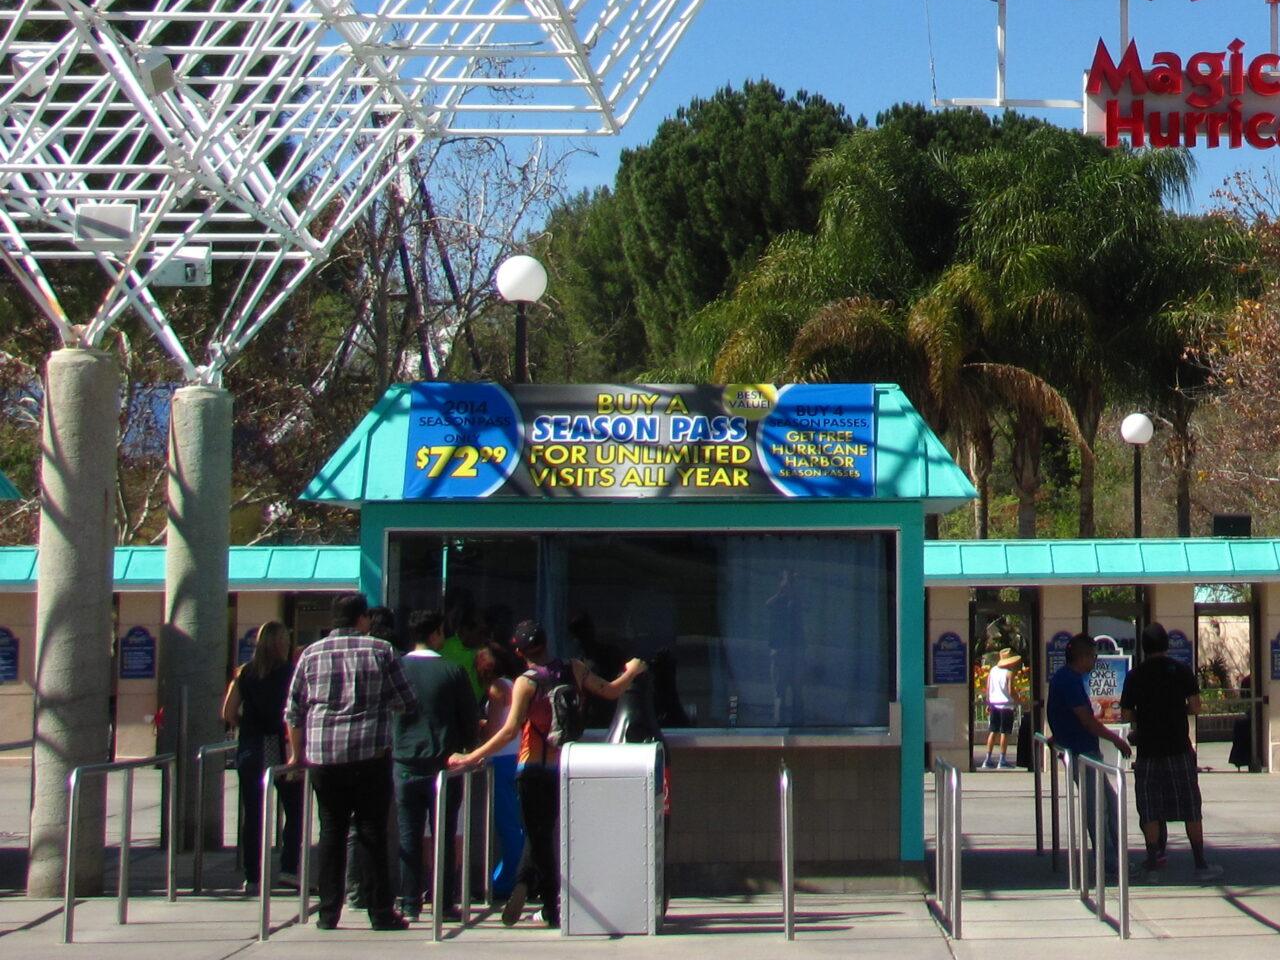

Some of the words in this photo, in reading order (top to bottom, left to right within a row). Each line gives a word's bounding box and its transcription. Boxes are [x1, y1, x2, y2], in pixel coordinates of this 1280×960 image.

[737, 391, 764, 400] BEST
[444, 401, 488, 414] 2014
[597, 393, 659, 415] BUY
[665, 393, 689, 415] A
[729, 400, 771, 409] VALUE!
[796, 405, 829, 416] BUY
[833, 404, 844, 416] 4
[418, 416, 474, 426] SEASON
[478, 416, 512, 426] PASS
[769, 419, 821, 428] SEASON
[824, 419, 870, 428] PASSES,
[531, 415, 660, 442] SEASON
[669, 416, 749, 442] PASS
[786, 431, 816, 442] GET
[819, 431, 853, 442] FREE
[529, 445, 588, 464] FOR
[595, 444, 751, 465] UNLIMITED
[771, 444, 868, 456] HURRICANE
[785, 456, 854, 468] HARBOR
[529, 467, 616, 487] VISITS
[620, 468, 671, 487] ALL
[675, 468, 750, 487] YEAR
[779, 469, 821, 477] SEASON
[824, 469, 860, 478] PASSES
[1096, 662, 1110, 670] PAY
[1090, 670, 1116, 679] ONCE
[1088, 679, 1103, 687] EAT
[1104, 678, 1117, 687] ALL
[1091, 687, 1114, 696] YEAR!
